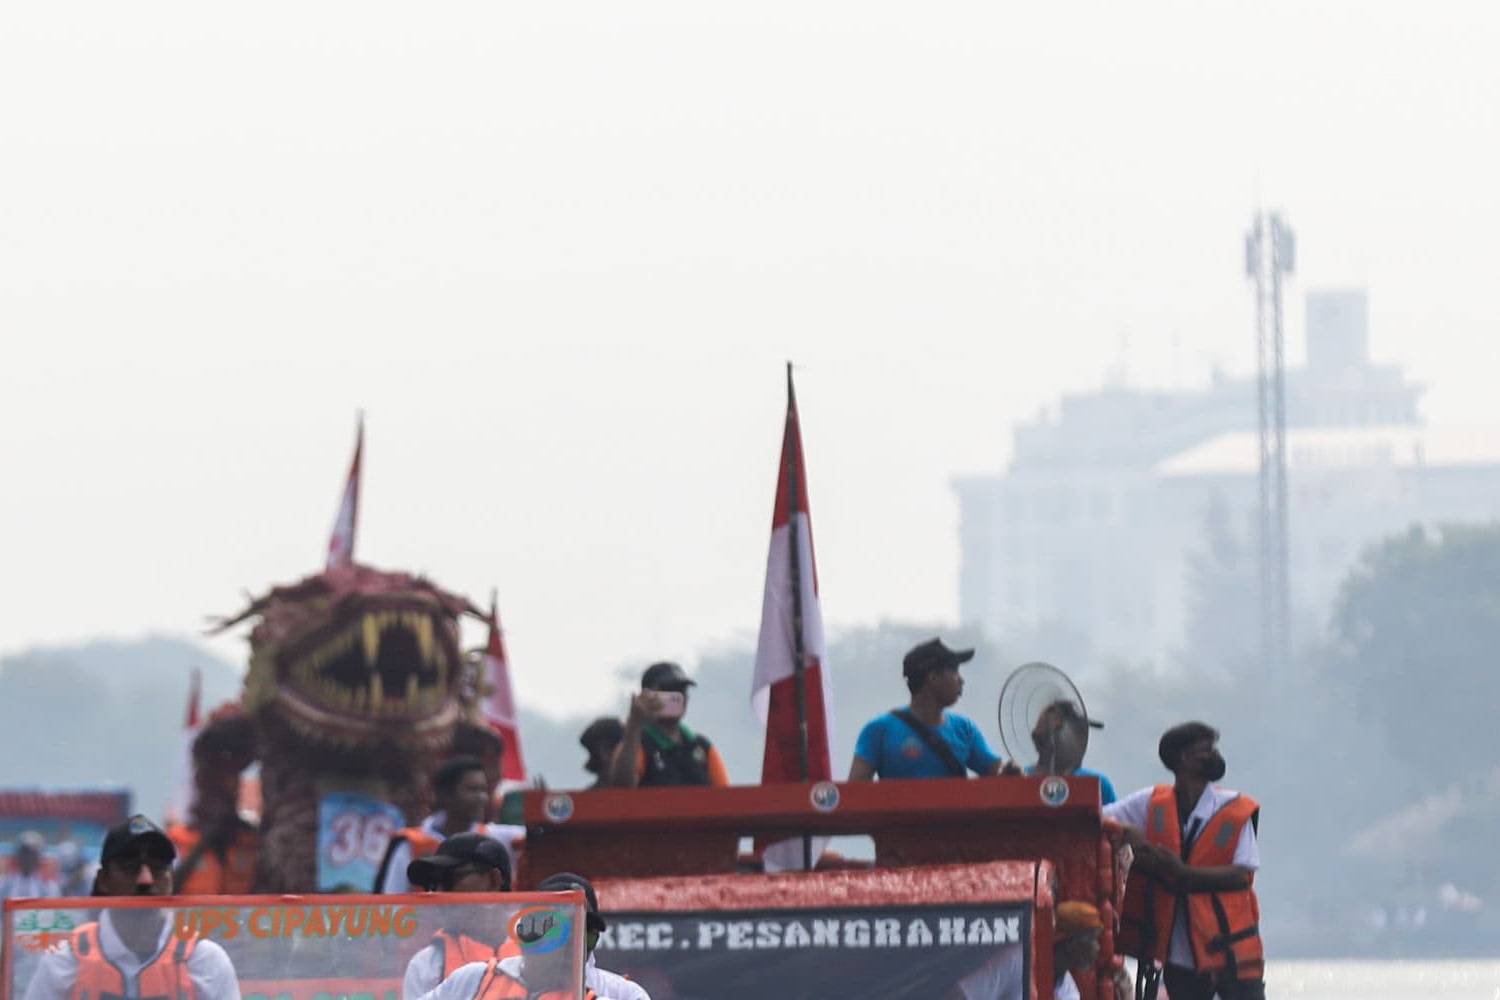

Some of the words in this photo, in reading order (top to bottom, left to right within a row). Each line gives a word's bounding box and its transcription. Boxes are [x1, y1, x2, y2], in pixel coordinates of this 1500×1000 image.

[329, 812, 396, 867] 36
[174, 907, 241, 941] UPS
[249, 905, 418, 938] CIPAYUNG
